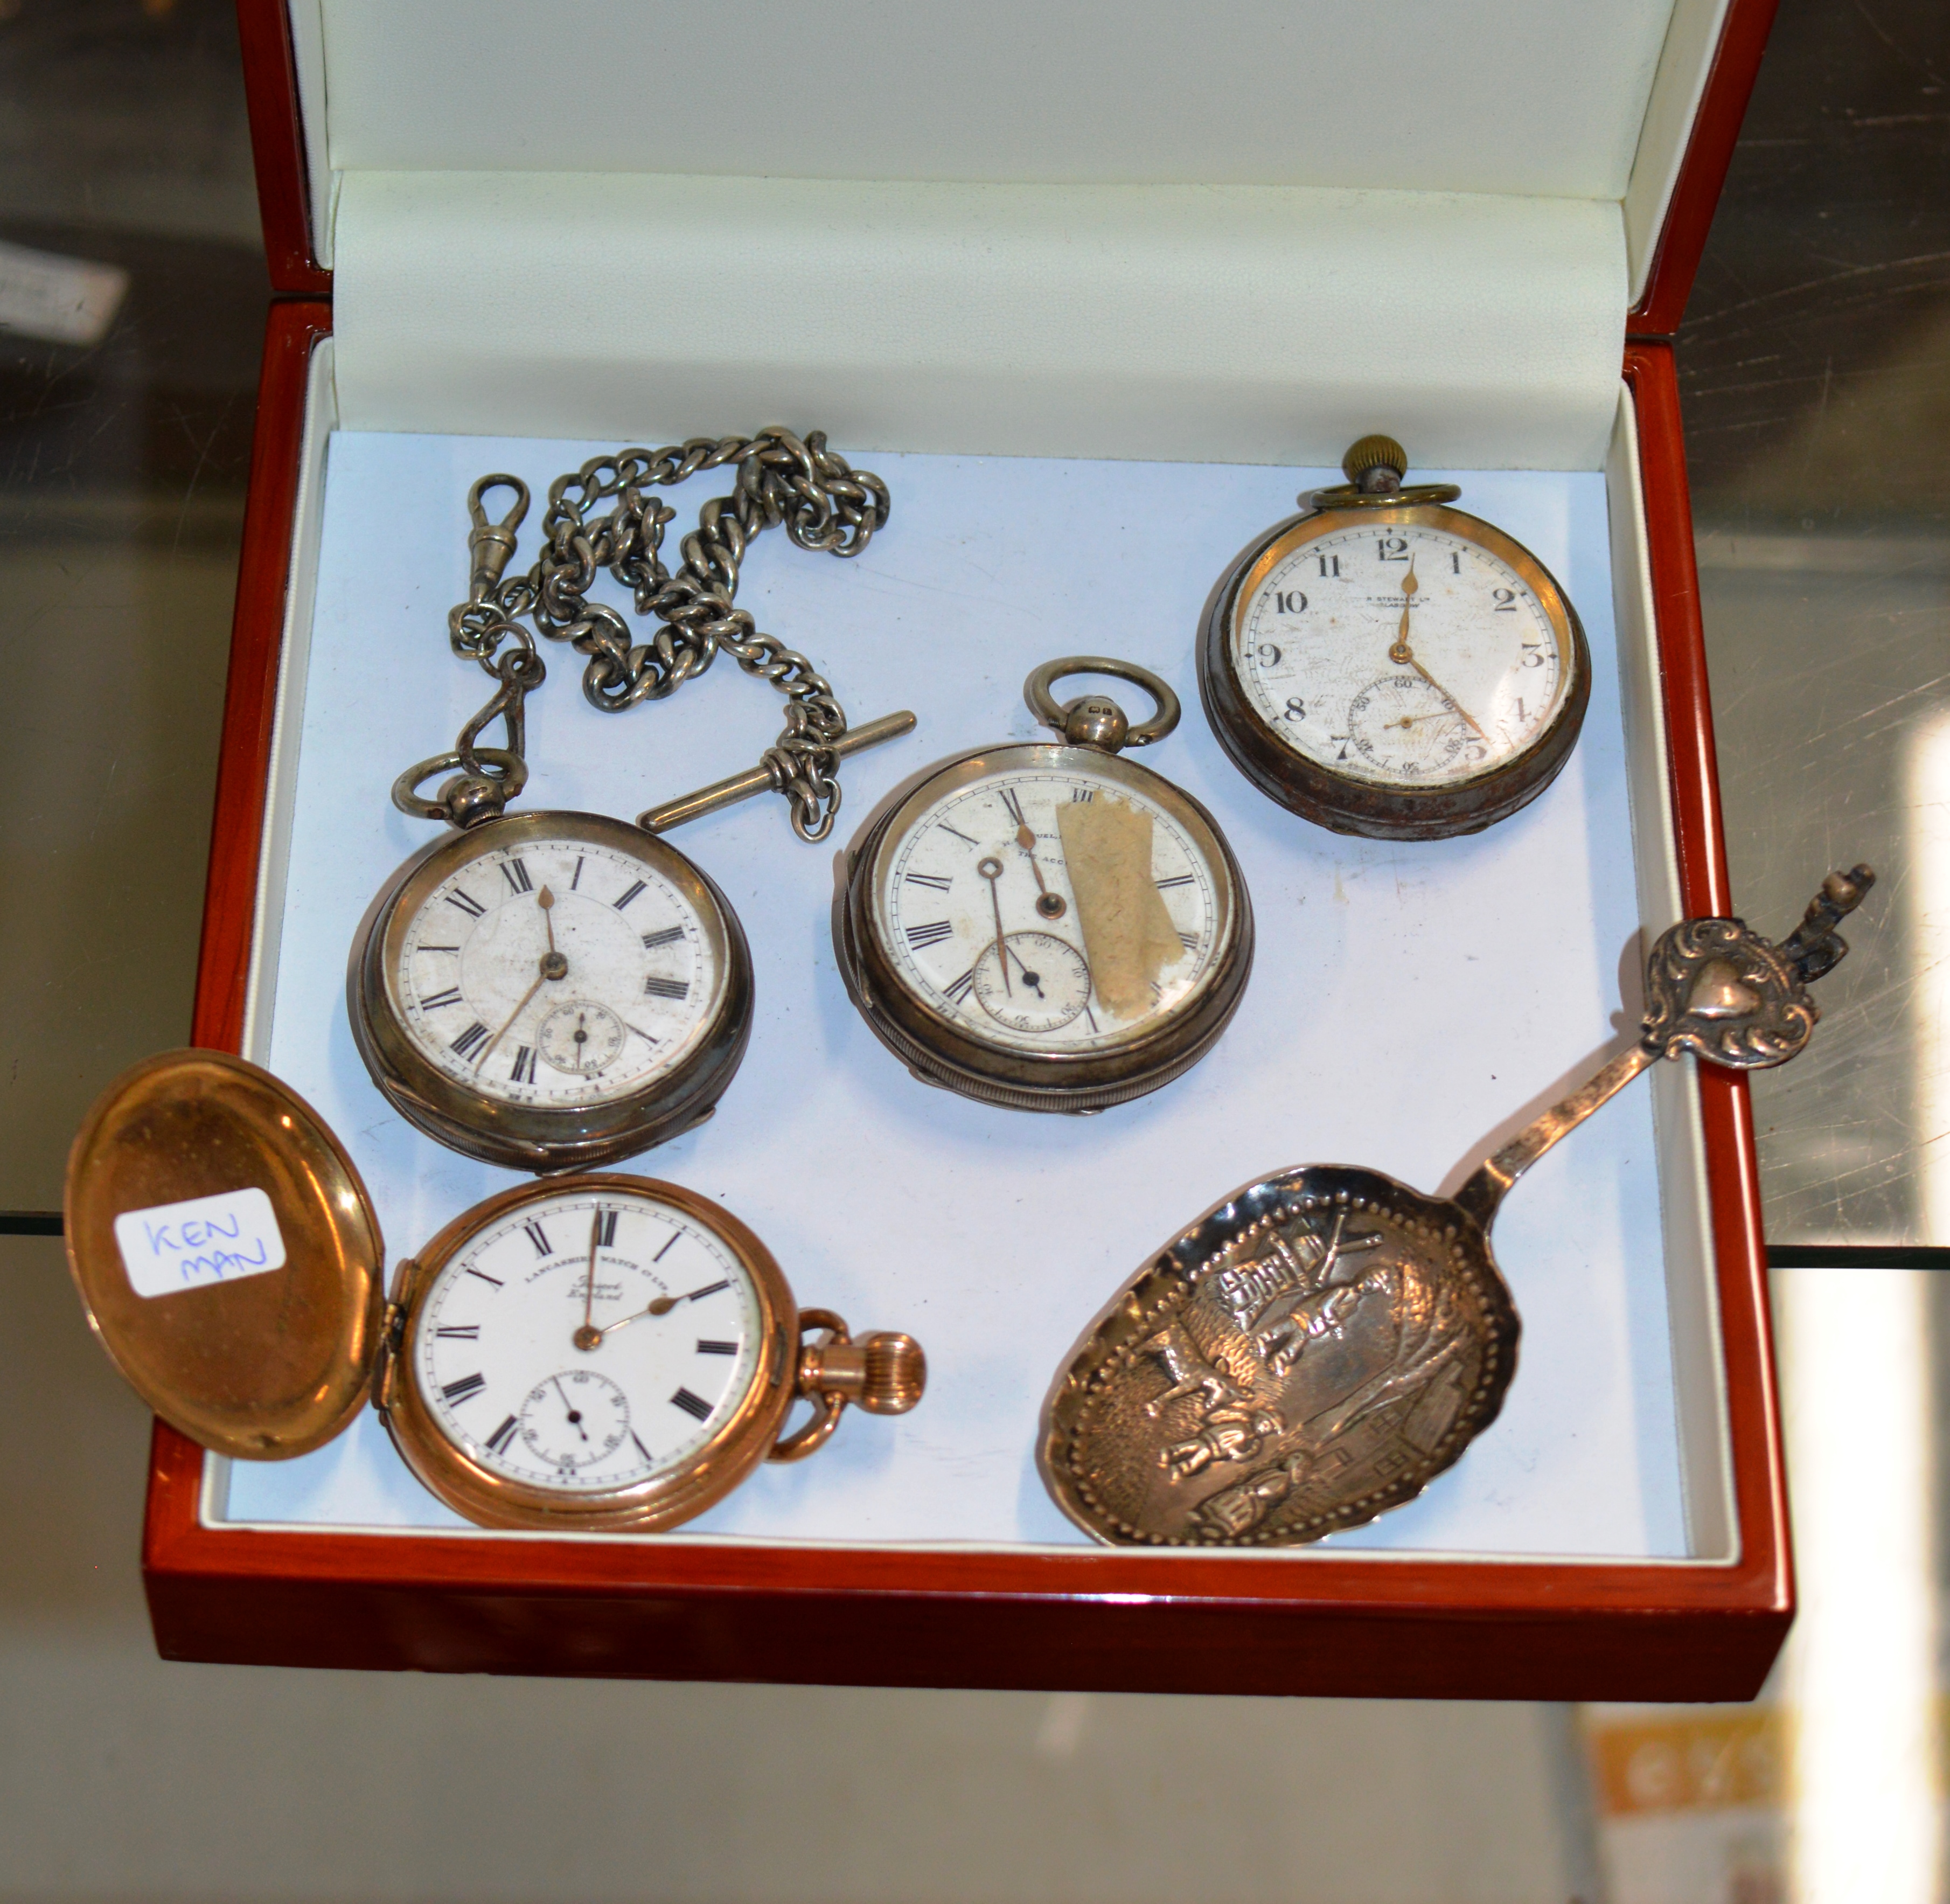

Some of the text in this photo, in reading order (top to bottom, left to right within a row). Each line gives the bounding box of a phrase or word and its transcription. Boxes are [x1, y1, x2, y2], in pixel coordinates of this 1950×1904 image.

[1377, 538, 1409, 561] 12
[1318, 554, 1340, 577] 11
[1450, 552, 1461, 574] 1
[1275, 590, 1308, 614] 10
[1493, 588, 1517, 611] 2
[1258, 643, 1282, 668] 9
[1521, 642, 1545, 668] 3
[1394, 679, 1413, 689] 60
[1284, 697, 1306, 722] 8
[1355, 696, 1370, 712] 50
[1506, 697, 1532, 722] 4
[1329, 735, 1352, 760] 7
[1465, 736, 1487, 761] 5
[496, 857, 537, 897] XII
[569, 855, 586, 891] I
[444, 886, 489, 922] XI
[612, 878, 650, 911] II
[641, 925, 687, 949] III
[905, 920, 954, 951] VIII
[1034, 939, 1051, 949] 60
[644, 976, 690, 1000] IIII
[142, 1213, 240, 1256] KEN
[524, 1220, 555, 1261] XI
[652, 1231, 683, 1263] I
[180, 1237, 267, 1282] MAN
[524, 1255, 590, 1283] LANCASHIR
[600, 1255, 640, 1270] WATCH
[695, 1339, 740, 1357] III
